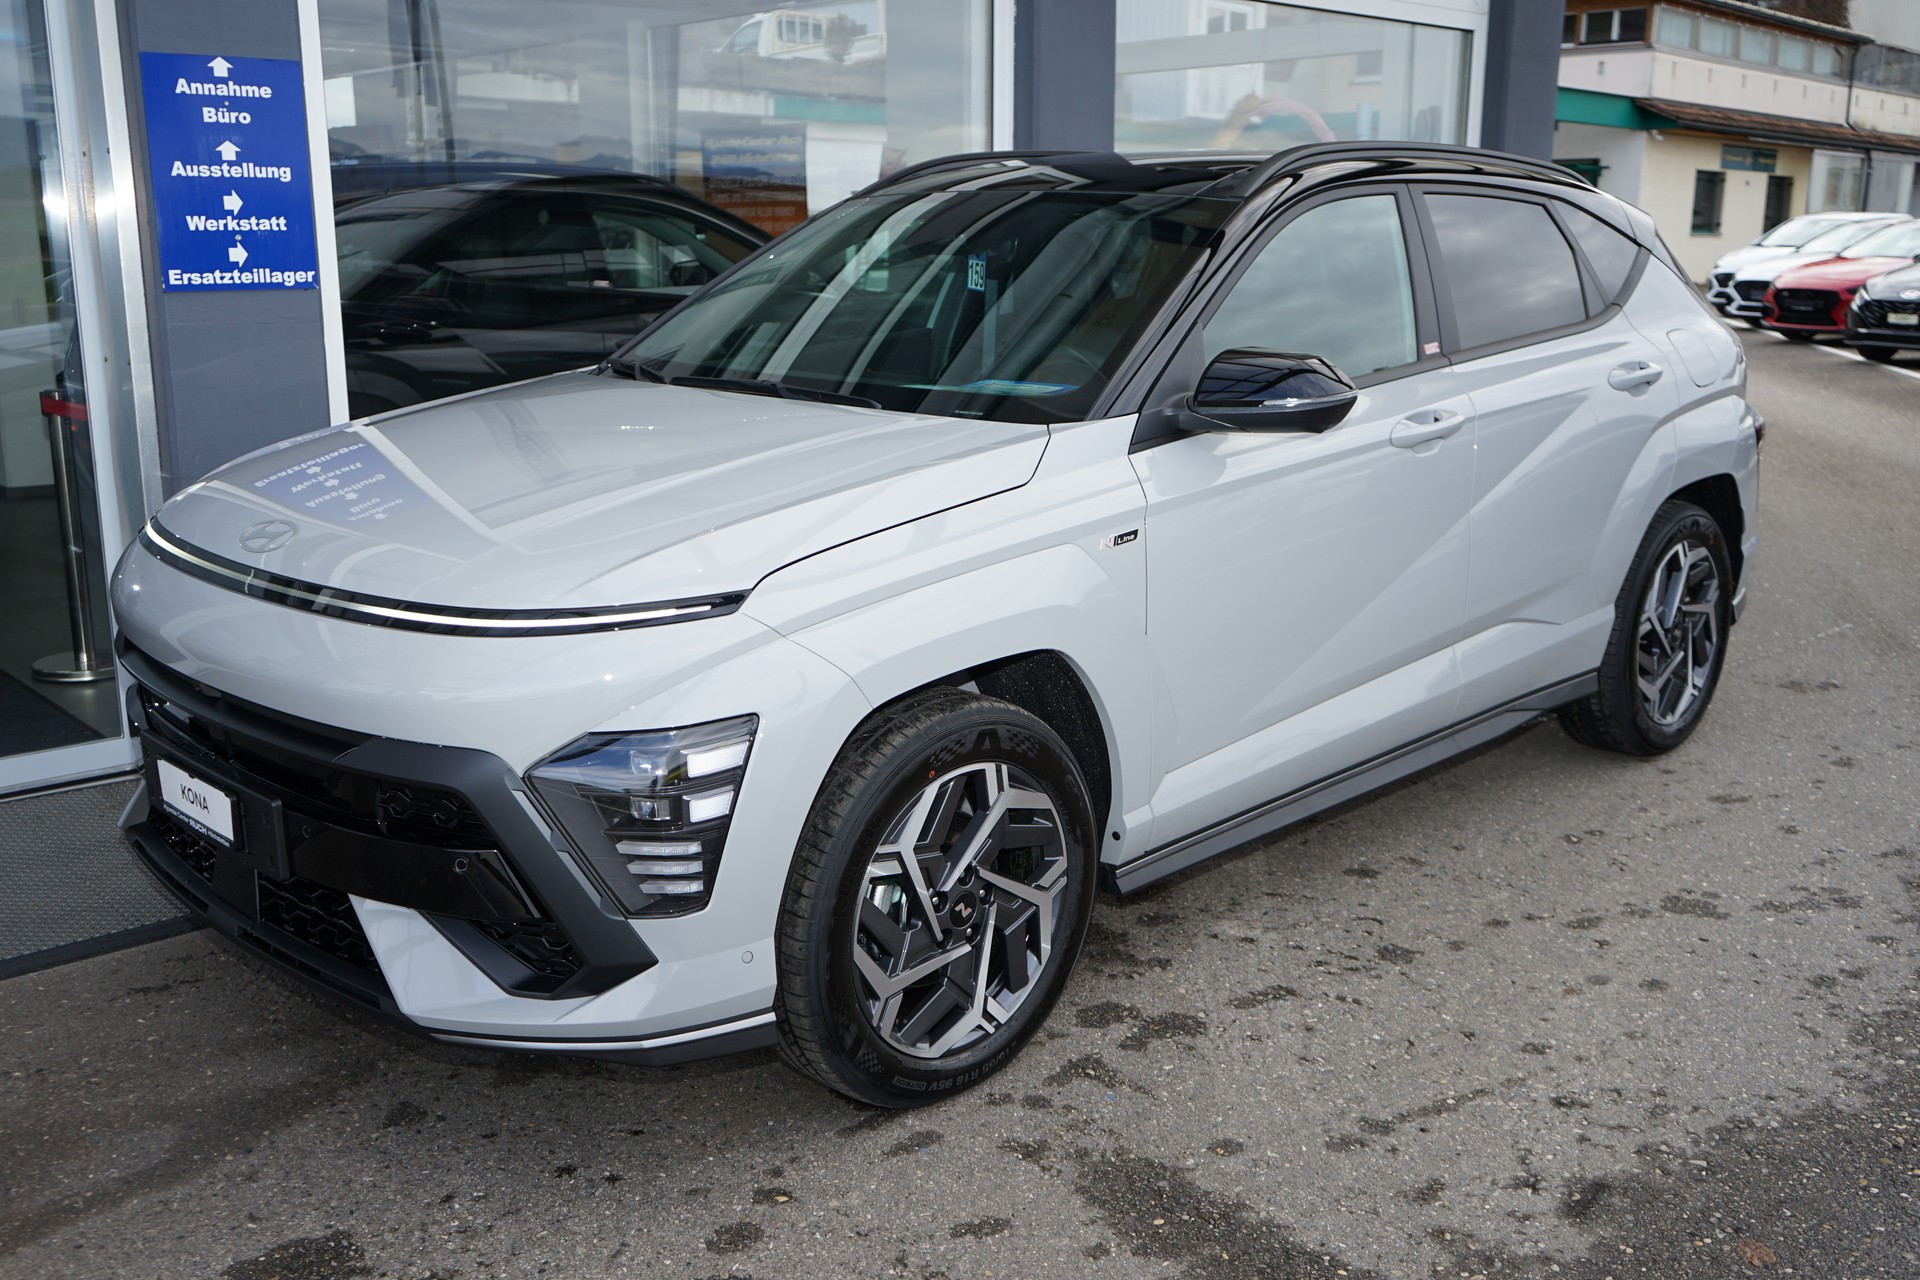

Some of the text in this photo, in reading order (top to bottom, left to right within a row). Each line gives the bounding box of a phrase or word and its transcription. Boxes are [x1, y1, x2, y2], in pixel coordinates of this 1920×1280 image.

[175, 78, 272, 98] Annahme
[202, 107, 252, 124] Büro
[171, 161, 292, 182] Ausstellung
[186, 215, 288, 231] Werkstatt
[168, 268, 316, 286] Ersatzteillager
[969, 261, 985, 289] 159
[1117, 534, 1135, 544] Line
[180, 783, 210, 814] KONA
[189, 818, 208, 835] RUCH
[893, 1077, 927, 1091] OUTSIDE
[927, 1078, 953, 1091] 95V
[956, 1069, 979, 1084] R18
